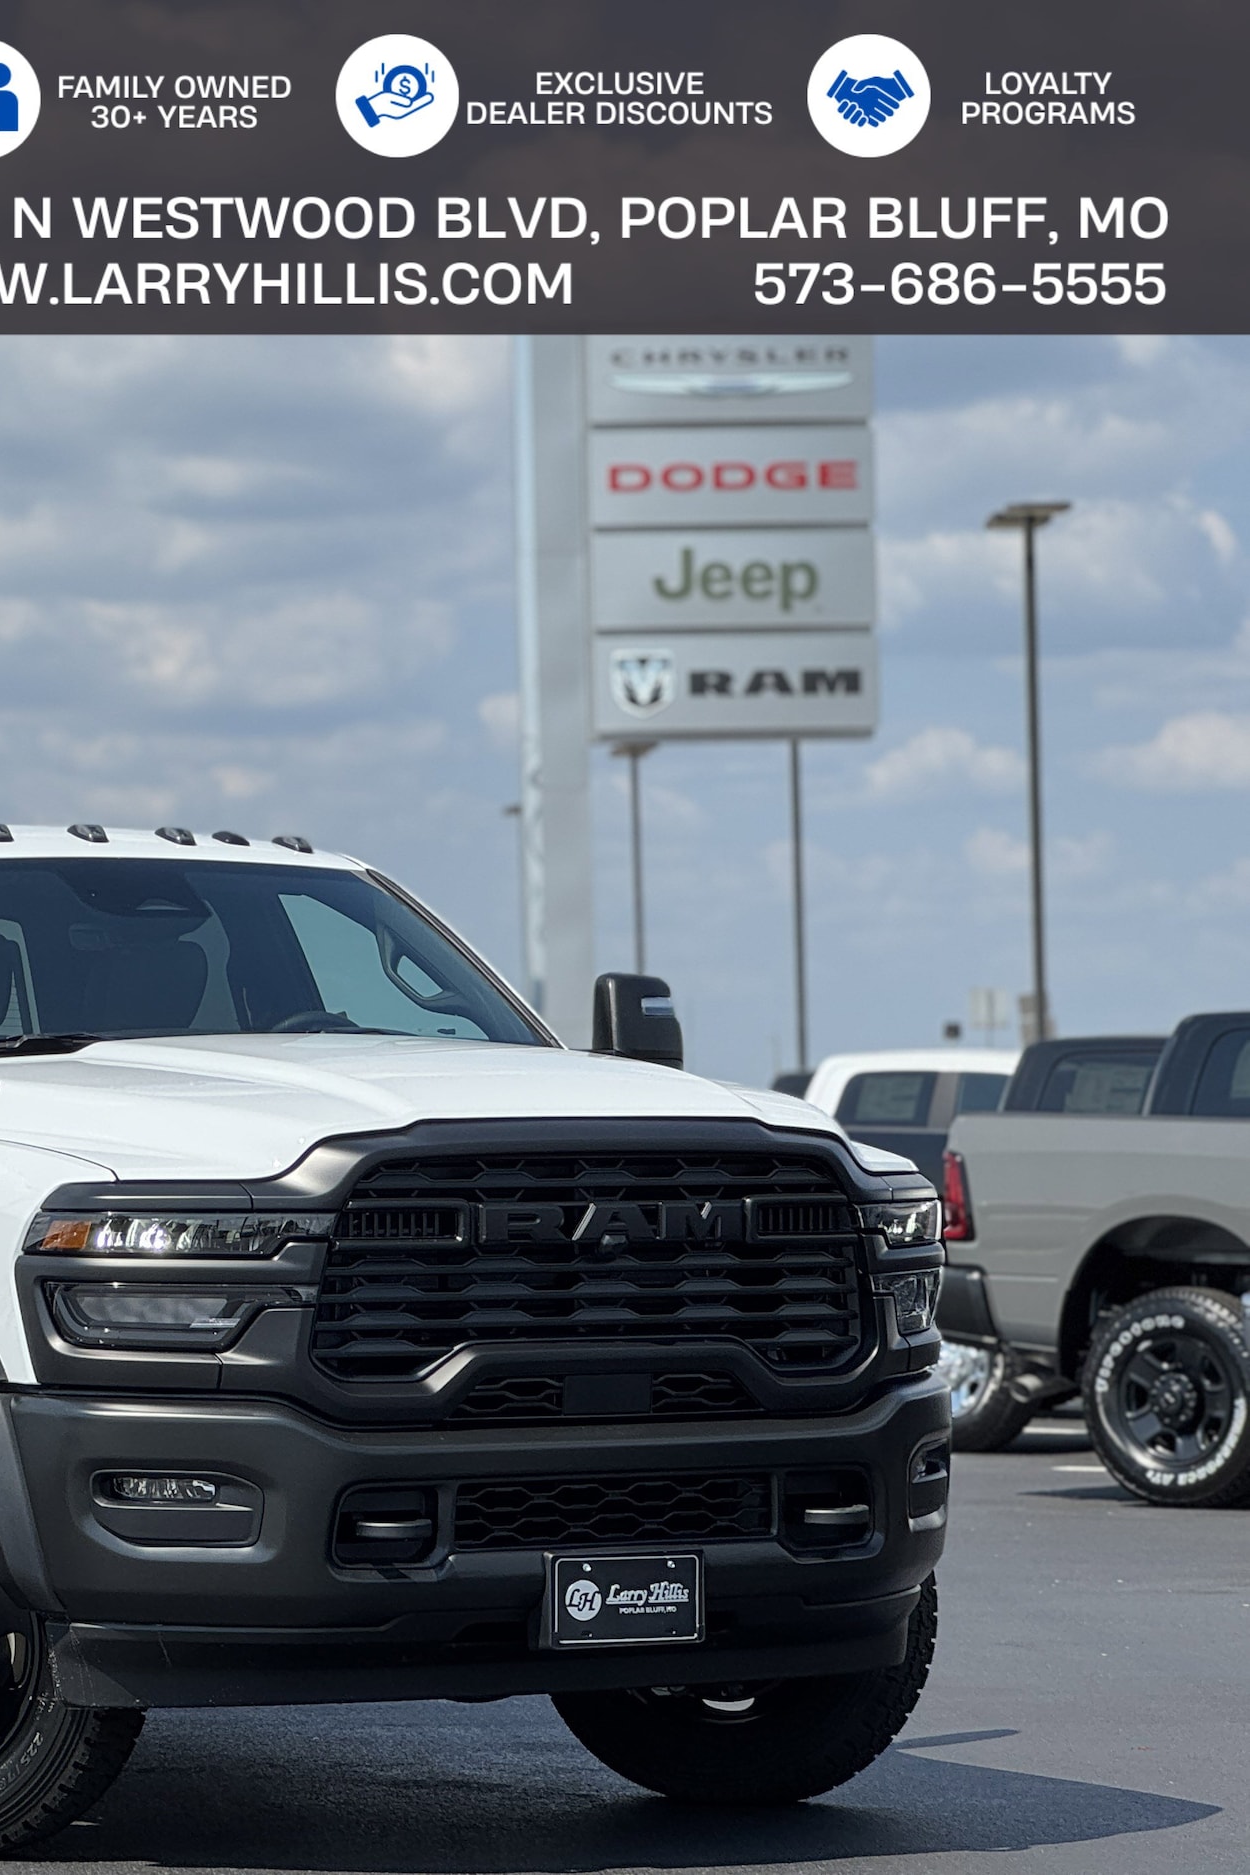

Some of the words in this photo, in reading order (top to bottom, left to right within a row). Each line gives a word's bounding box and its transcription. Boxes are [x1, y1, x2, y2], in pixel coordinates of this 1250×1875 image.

[607, 460, 860, 493] DODGE
[653, 547, 819, 613] Jeep
[688, 668, 863, 697] RAM
[477, 1201, 745, 1244] RAM
[606, 1584, 648, 1606] Larry
[648, 1581, 690, 1604] Hillis
